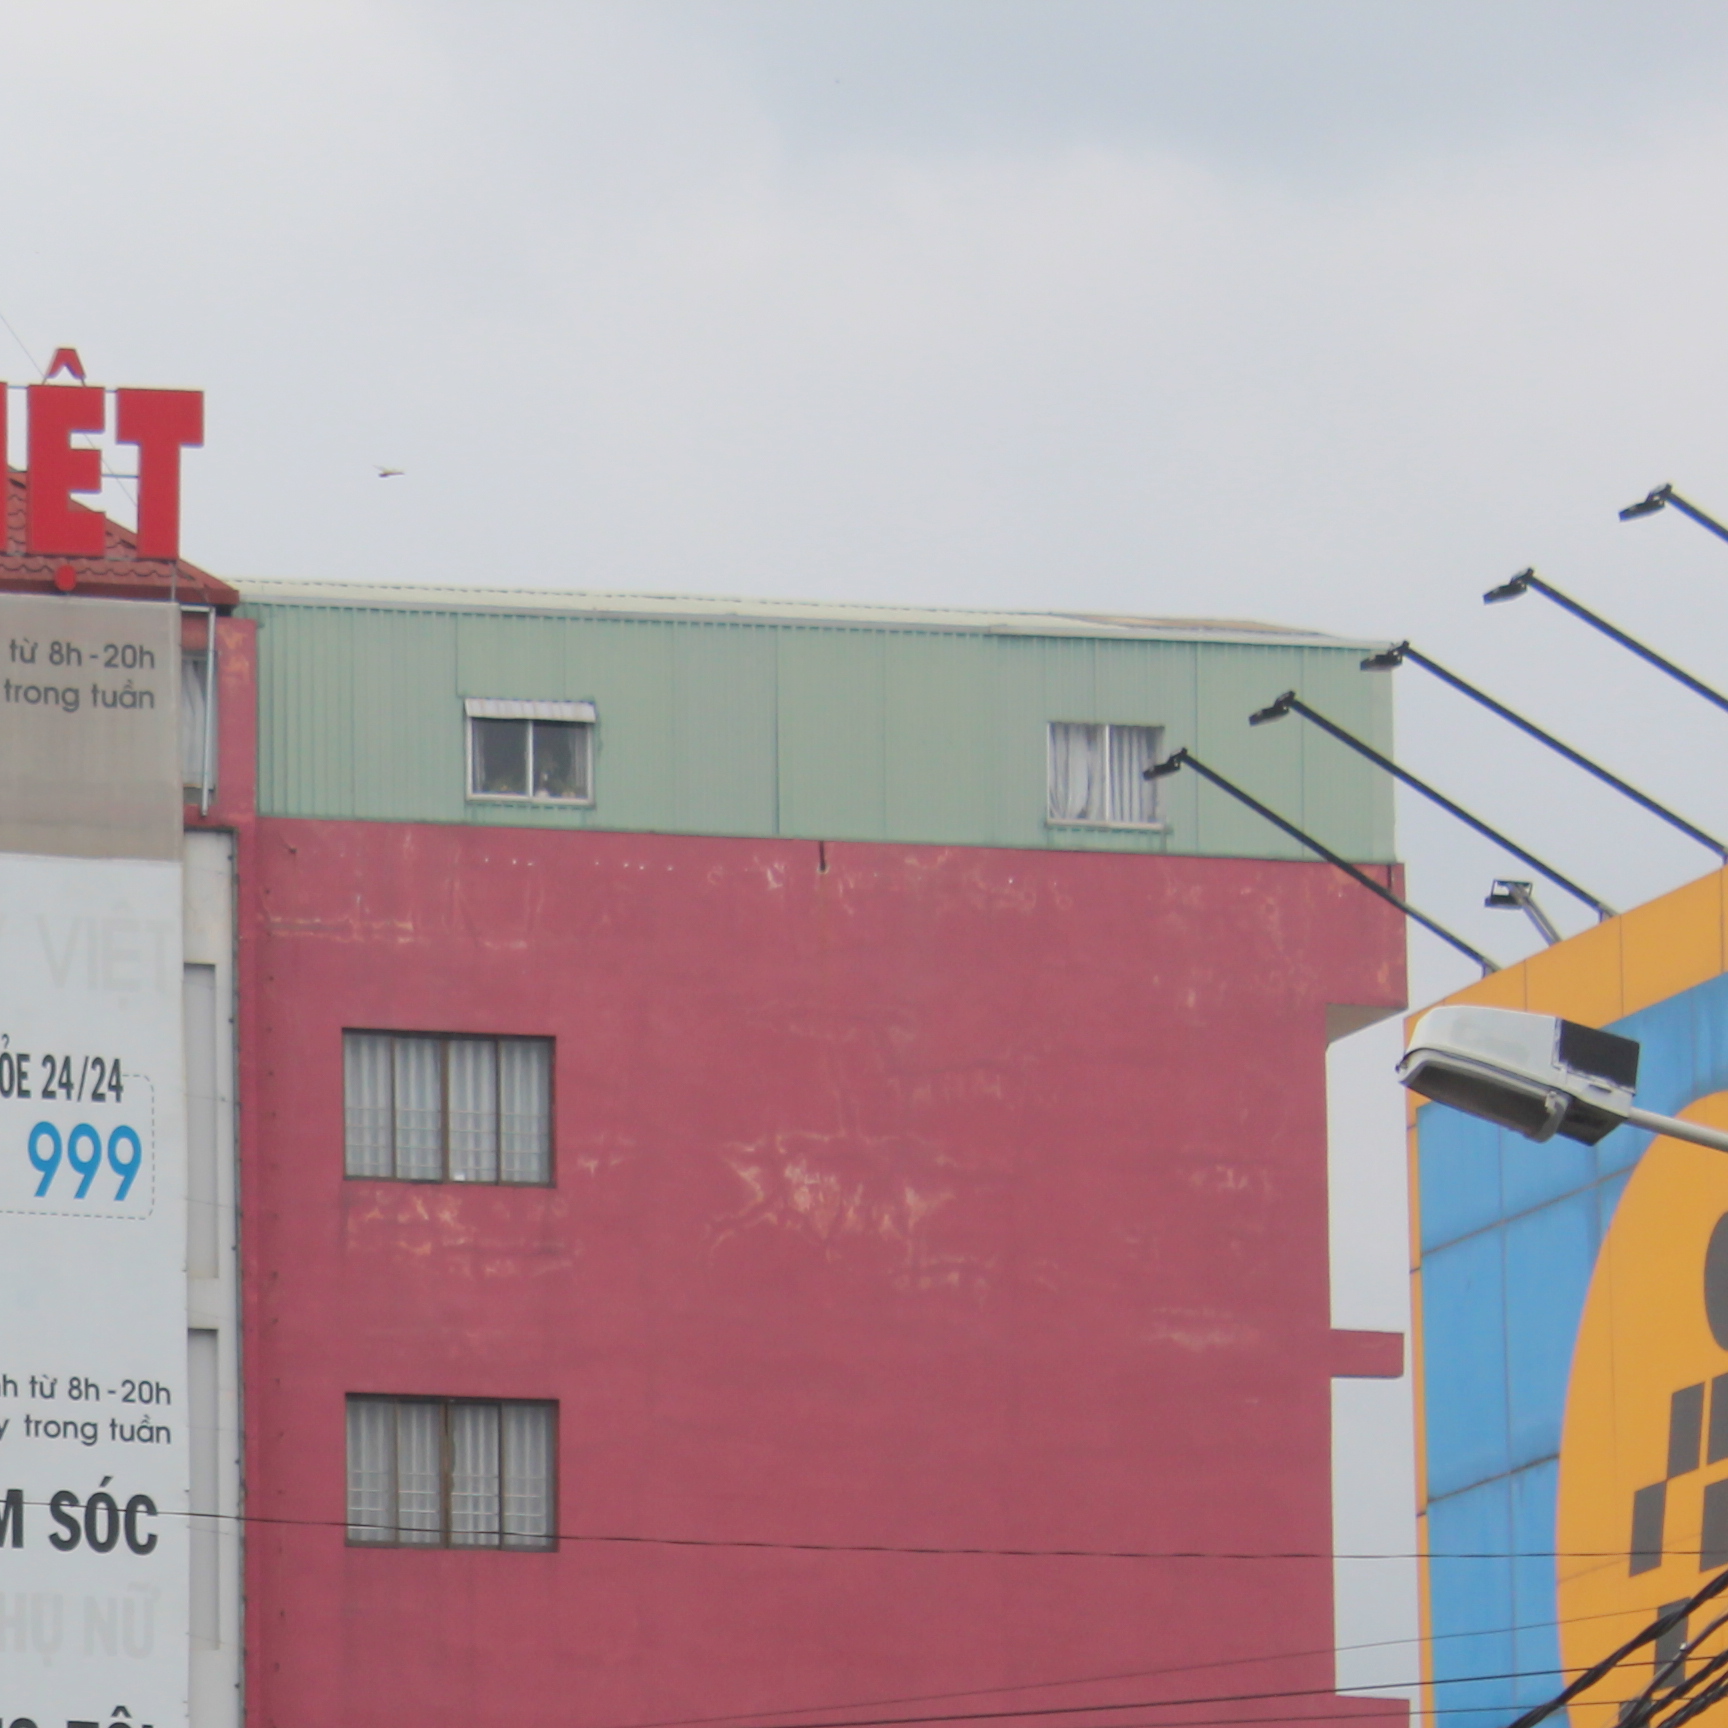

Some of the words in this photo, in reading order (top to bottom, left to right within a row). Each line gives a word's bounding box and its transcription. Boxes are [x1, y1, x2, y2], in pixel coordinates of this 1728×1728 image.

[9, 635, 39, 664] từ
[3, 676, 80, 714] trong
[91, 677, 156, 711] tuần
[41, 1055, 124, 1103] 24/24
[28, 1121, 143, 1201] 999
[28, 1373, 58, 1400] từ
[22, 1413, 99, 1447] trong
[110, 1415, 172, 1445] tuần
[48, 1476, 160, 1556] SÓC
